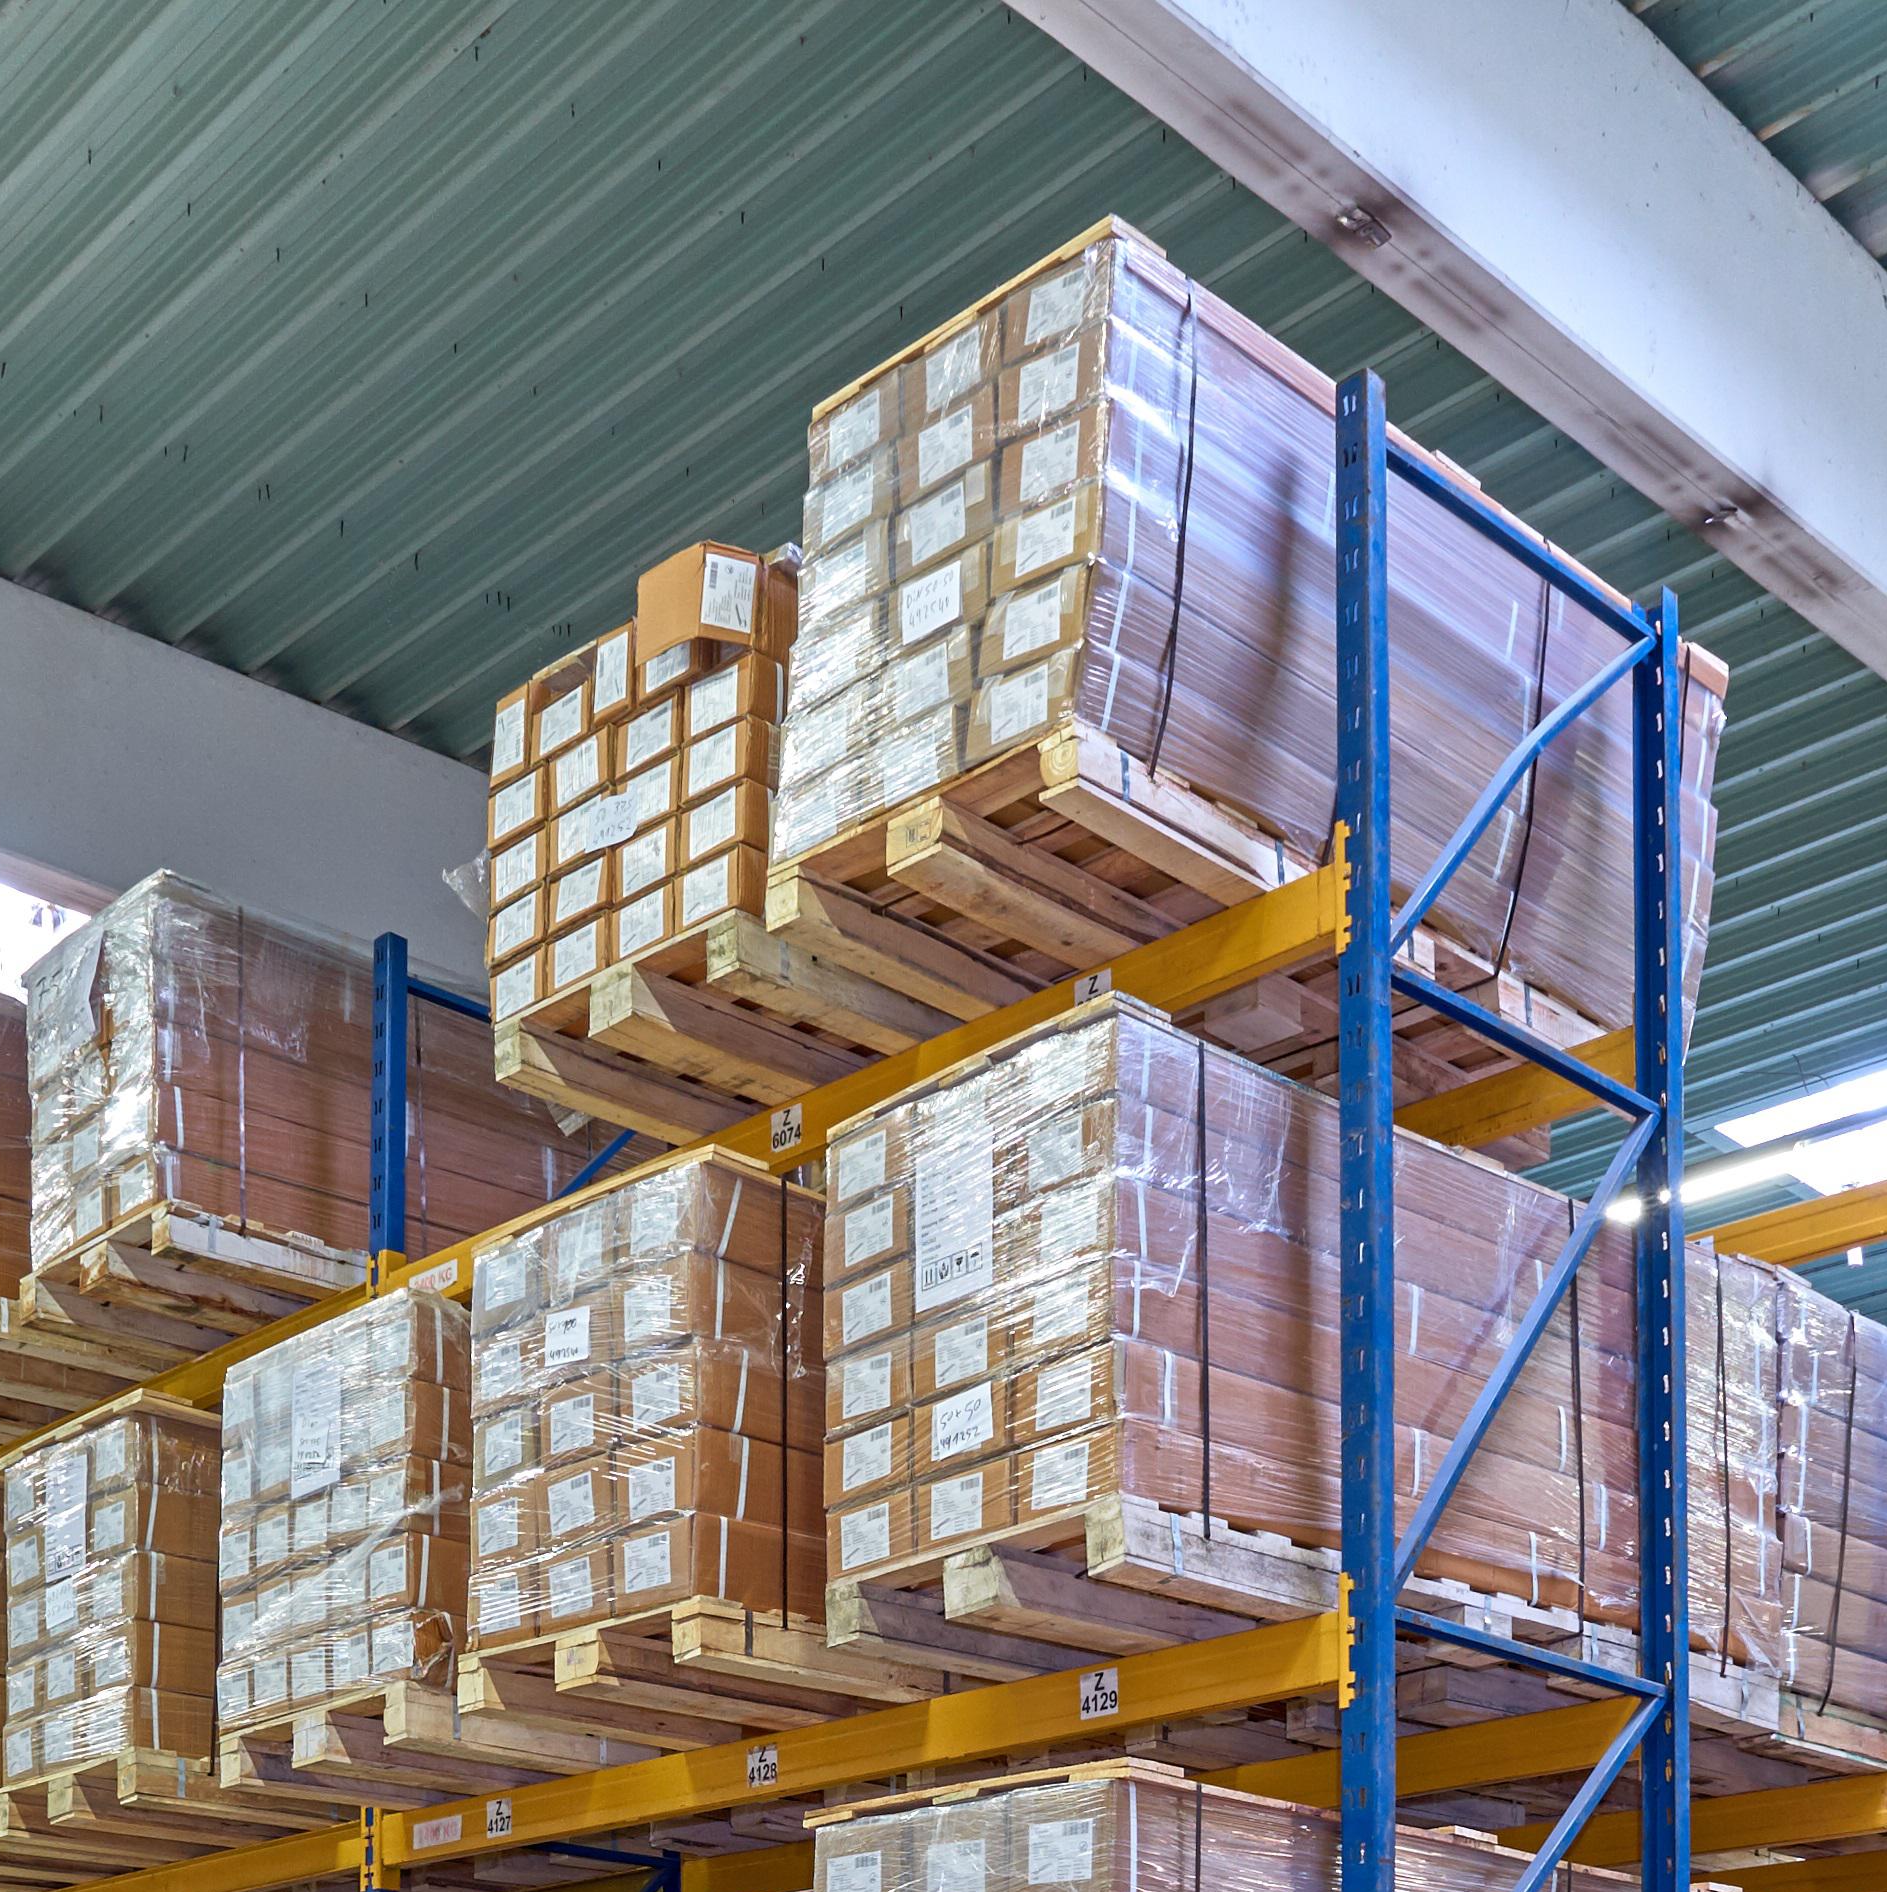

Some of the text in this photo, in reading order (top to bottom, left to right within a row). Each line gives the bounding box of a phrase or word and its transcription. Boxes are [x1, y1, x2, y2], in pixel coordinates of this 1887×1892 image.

[1088, 974, 1099, 995] Z
[782, 1108, 792, 1127] Z
[772, 1123, 801, 1150] 6074
[1094, 1671, 1106, 1692] Z
[1081, 1690, 1118, 1714] 4129
[748, 1762, 778, 1783] 4128
[496, 1800, 503, 1817] Z
[487, 1816, 512, 1835] 4127
